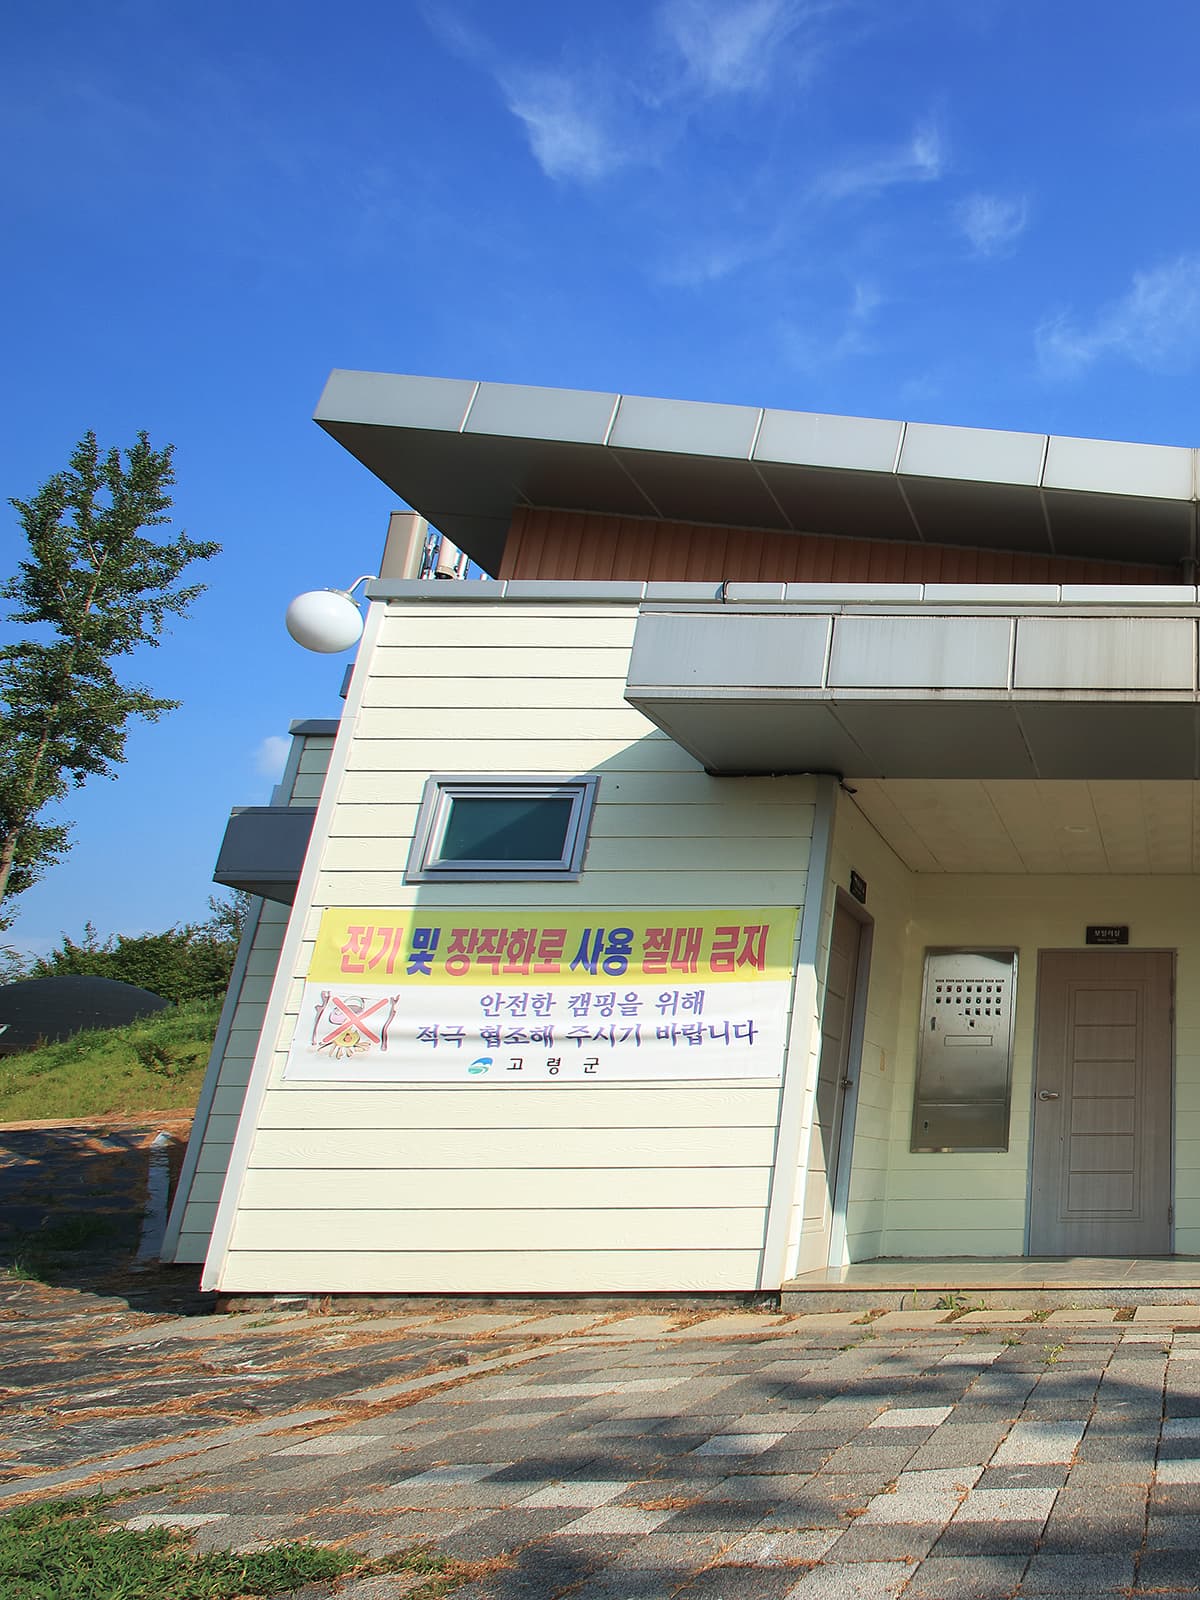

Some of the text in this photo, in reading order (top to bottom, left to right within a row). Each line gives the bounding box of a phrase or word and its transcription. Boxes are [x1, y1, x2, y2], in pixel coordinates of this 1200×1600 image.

[340, 924, 770, 977] 전기 및 장작화로 사용 절대 금지
[479, 989, 707, 1019] 안전한 캠핑을 위해
[415, 1019, 760, 1049] 적극 협조해 주시기 바랍니다
